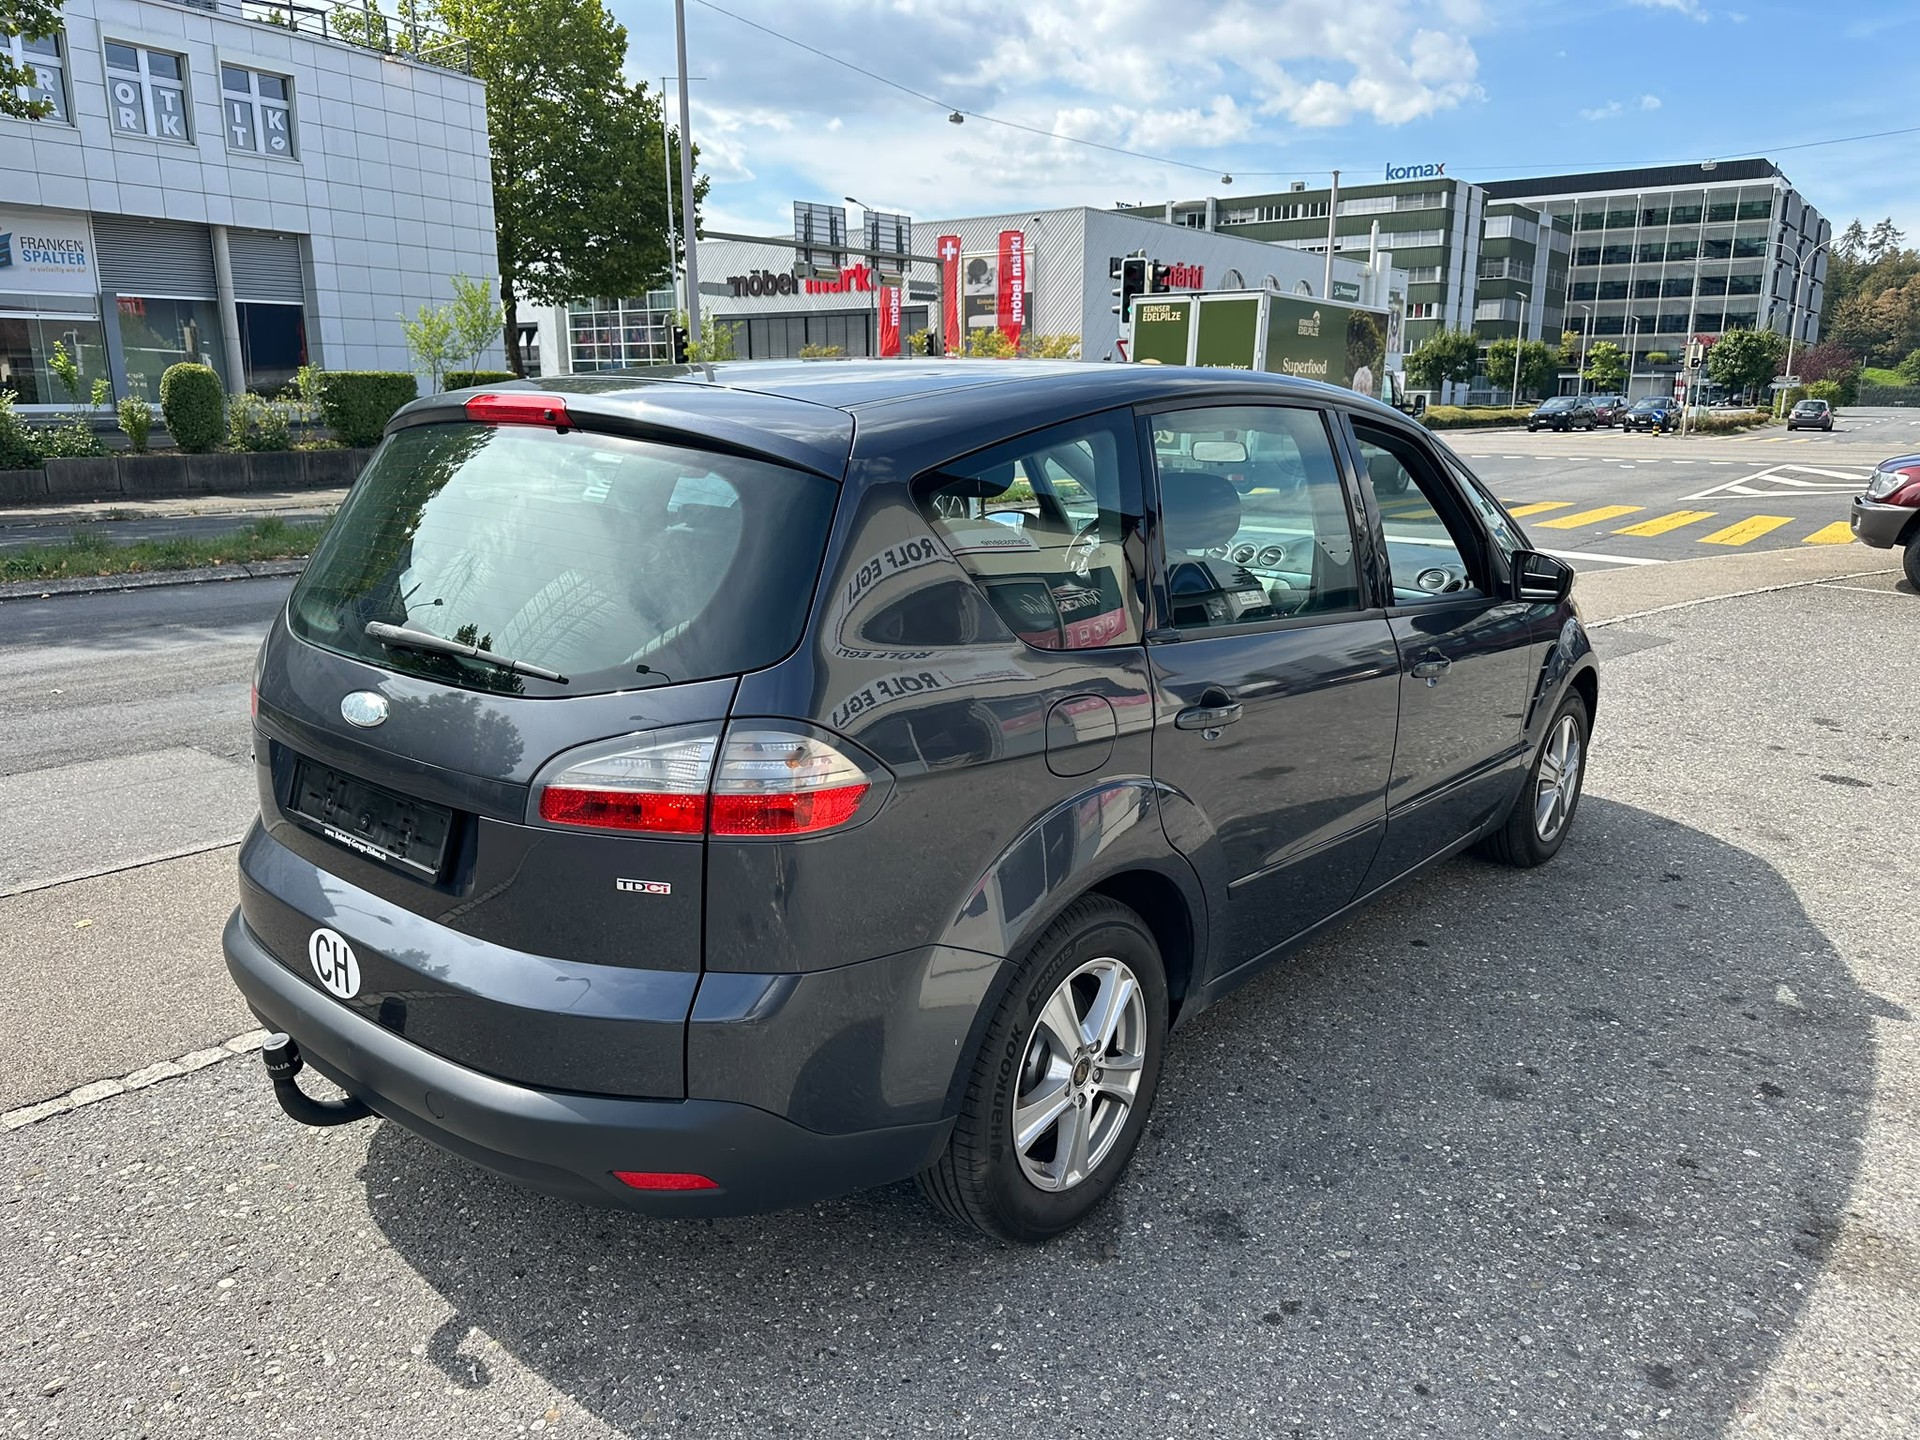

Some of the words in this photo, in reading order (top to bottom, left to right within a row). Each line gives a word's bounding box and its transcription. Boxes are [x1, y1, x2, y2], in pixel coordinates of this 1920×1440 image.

[1386, 163, 1446, 180] komax
[20, 237, 84, 252] FRANKEN
[22, 250, 86, 265] SPALTER
[1011, 236, 1022, 276] märki
[1011, 280, 1022, 322] möbel
[1143, 305, 1171, 313] KERNSER
[1142, 312, 1181, 322] EDELPILZE
[1282, 357, 1328, 377] Superfood
[316, 934, 350, 994] CH
